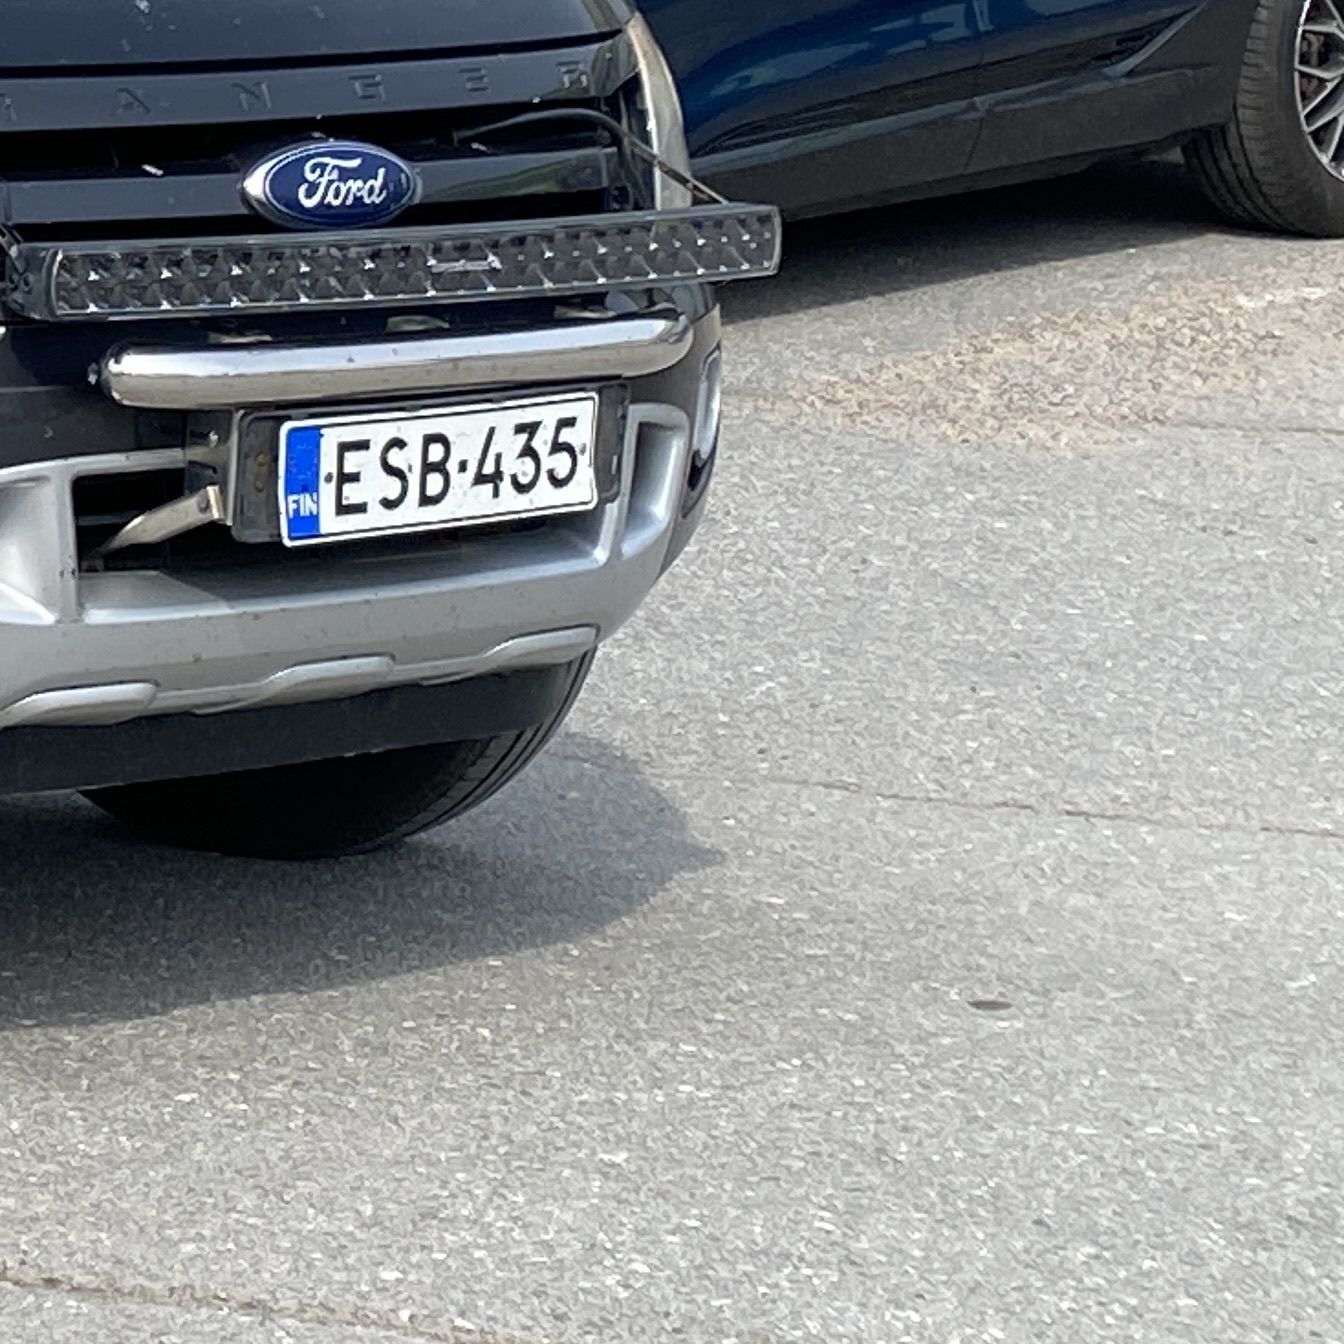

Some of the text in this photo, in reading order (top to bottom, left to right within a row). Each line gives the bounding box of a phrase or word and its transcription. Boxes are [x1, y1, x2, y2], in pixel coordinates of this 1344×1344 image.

[297, 157, 388, 208] Ford
[287, 416, 579, 520] FIN ESB-435
